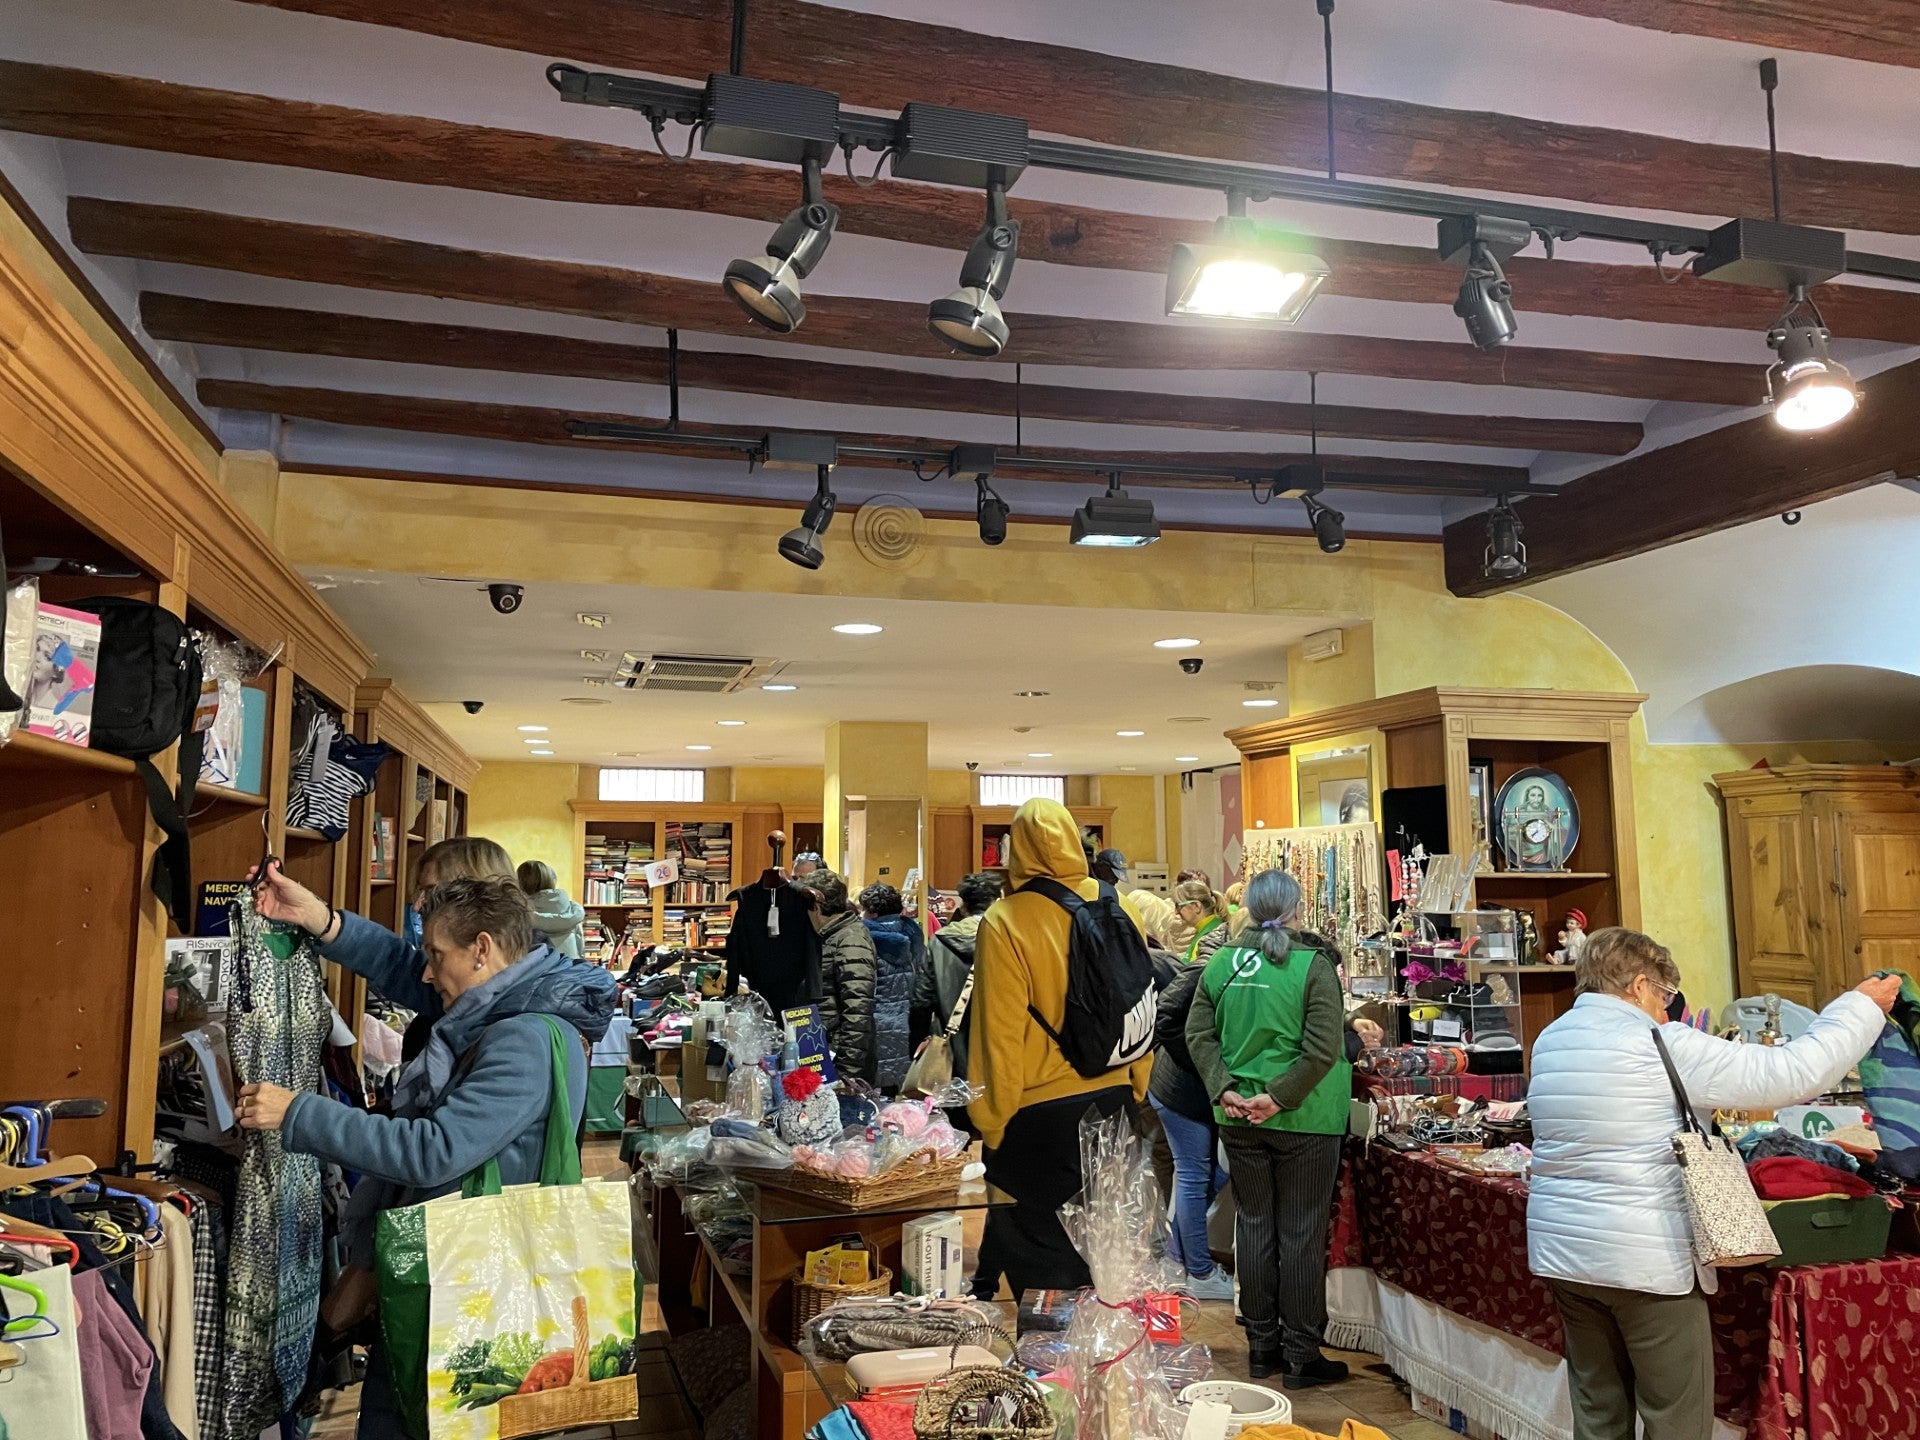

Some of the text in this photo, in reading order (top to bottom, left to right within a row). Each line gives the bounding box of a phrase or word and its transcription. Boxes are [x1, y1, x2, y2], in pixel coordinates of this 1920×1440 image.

[205, 884, 244, 893] MERCA
[204, 897, 228, 906] NAV
[220, 948, 231, 990] TOKYO
